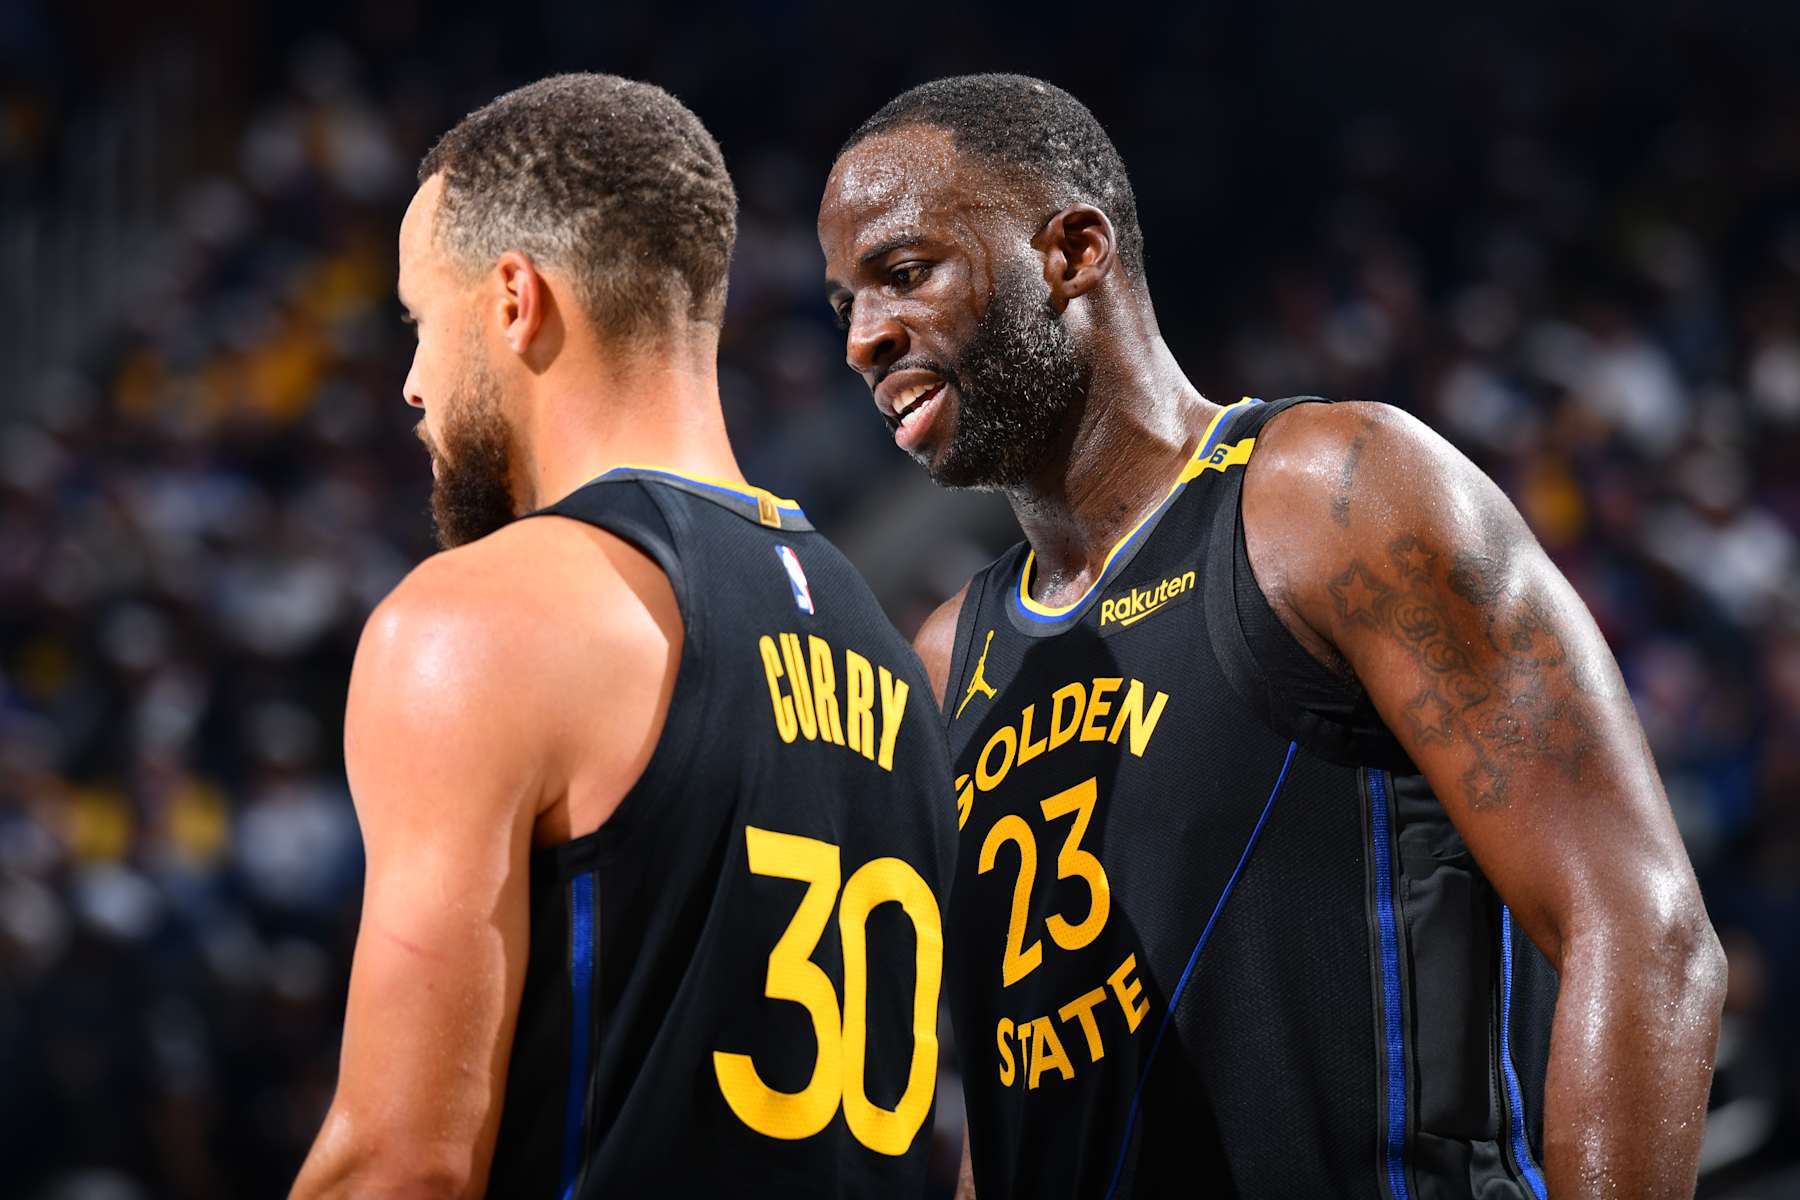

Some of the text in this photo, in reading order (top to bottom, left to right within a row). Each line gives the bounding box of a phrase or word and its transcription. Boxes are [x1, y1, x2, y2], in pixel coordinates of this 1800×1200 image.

[1209, 448, 1228, 465] 6
[1101, 572, 1196, 625] Rakuten
[759, 632, 910, 772] CURRY
[978, 776, 1111, 988] 23
[713, 825, 944, 1156] 30
[997, 953, 1150, 1090] STATE
